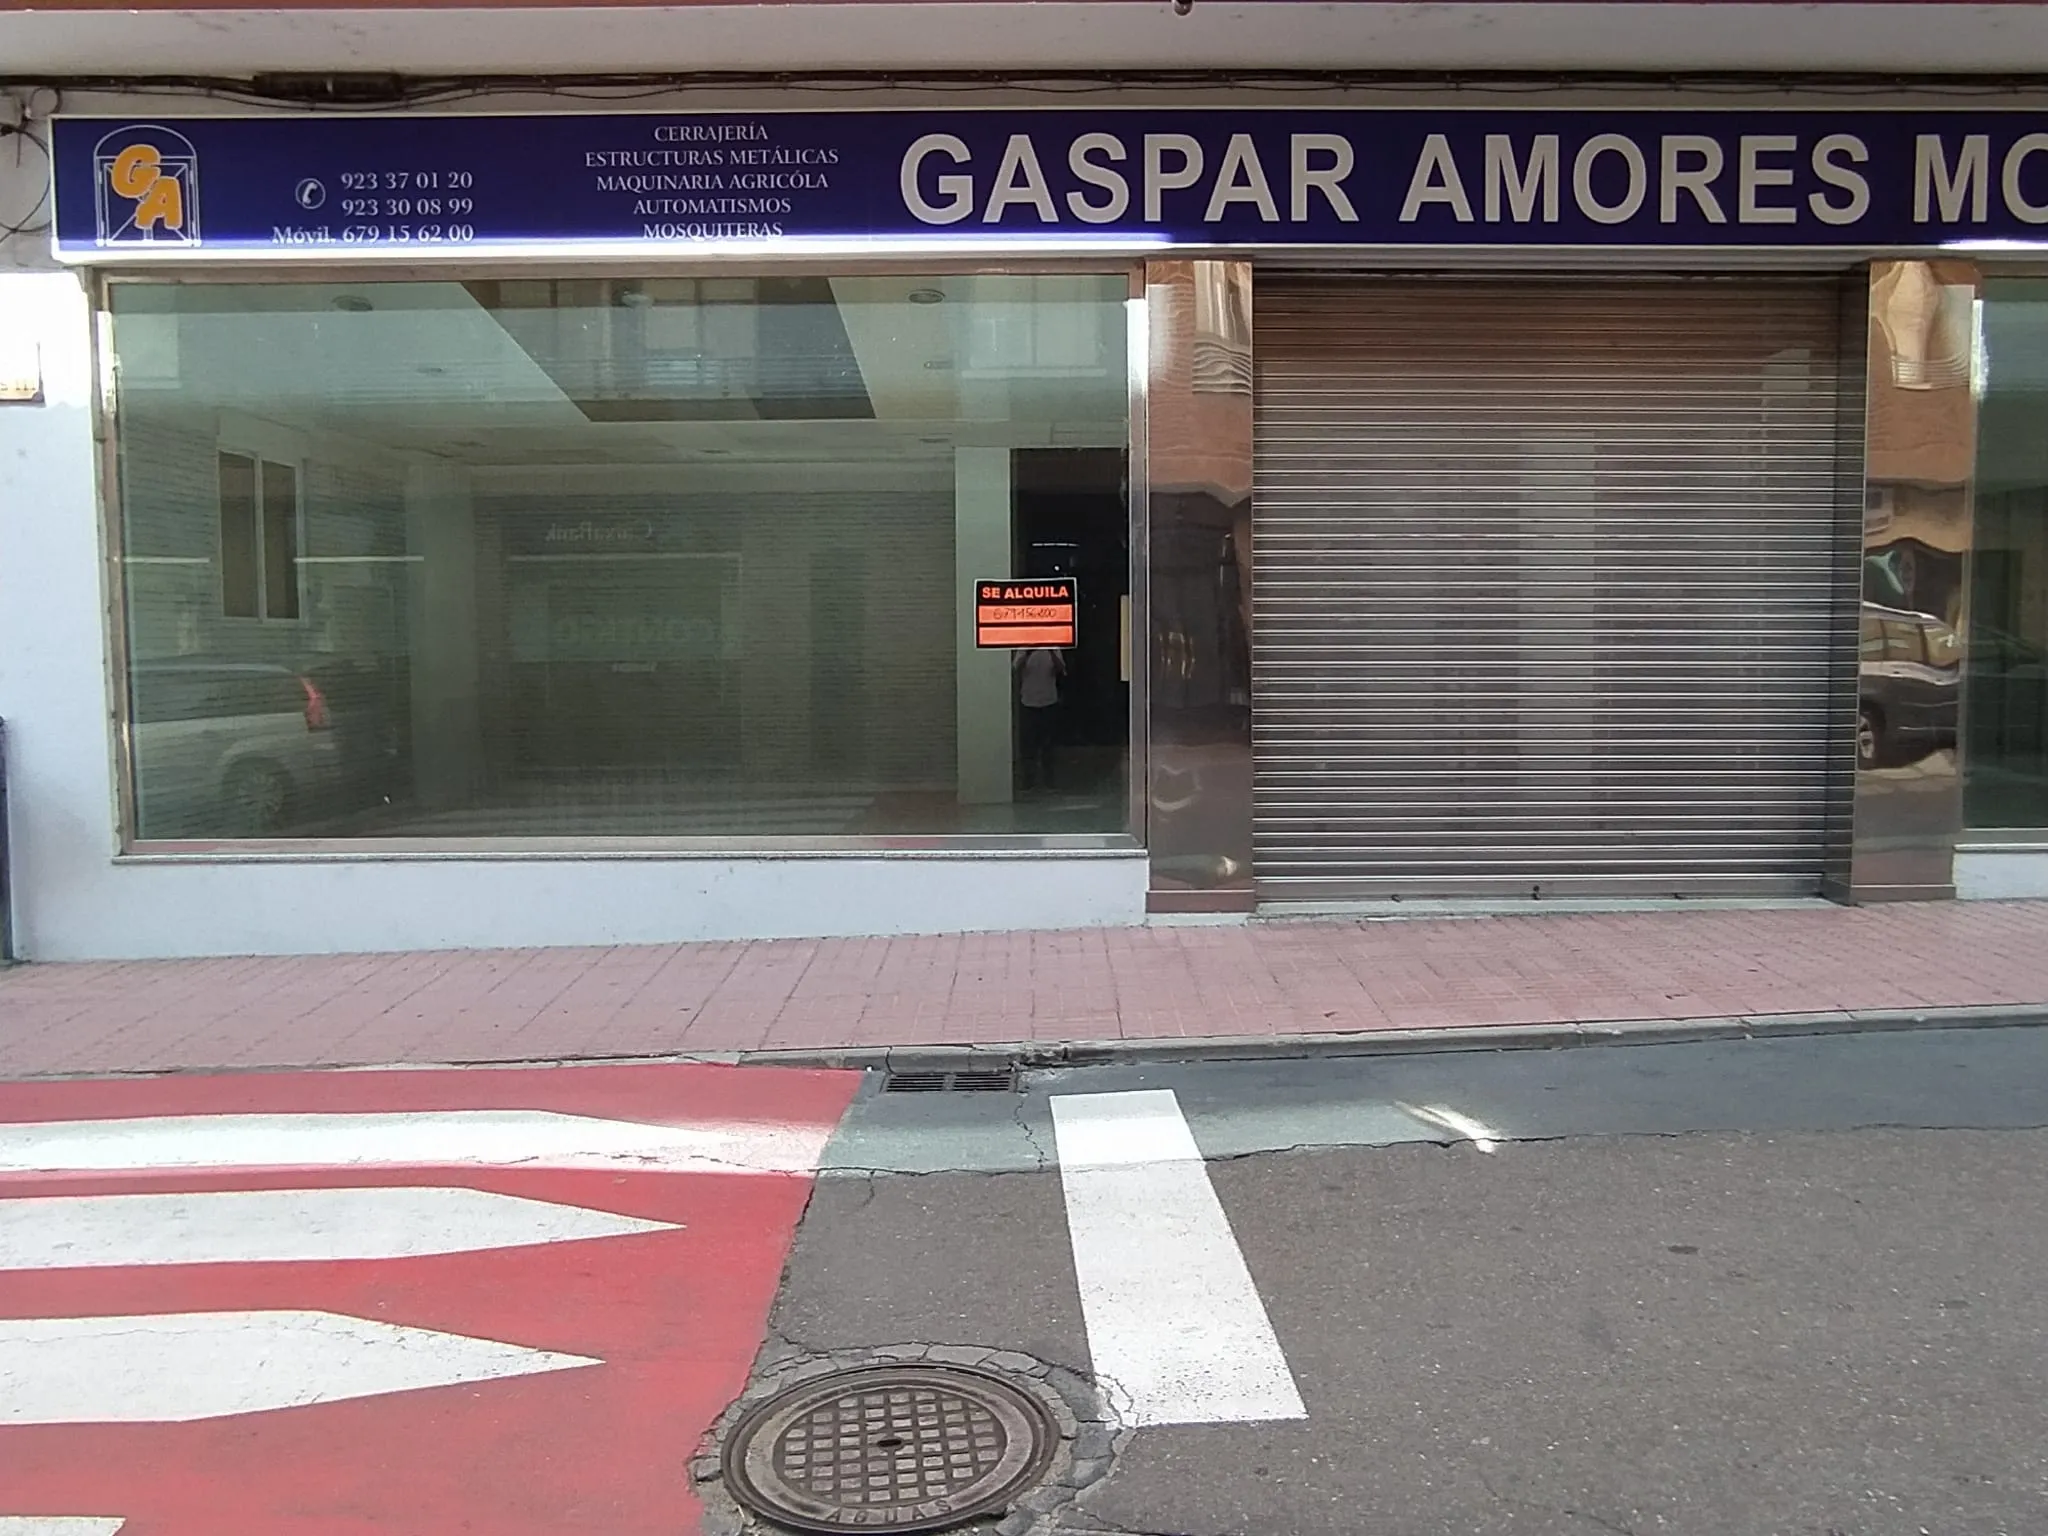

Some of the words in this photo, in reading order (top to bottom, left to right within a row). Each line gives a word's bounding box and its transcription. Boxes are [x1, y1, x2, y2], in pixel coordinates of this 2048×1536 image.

[653, 122, 768, 143] CERRAJERÍA
[584, 150, 723, 167] ESTRUCTURAS
[729, 145, 839, 165] METÁLICAS
[341, 172, 379, 191] 923
[385, 172, 410, 191] 37
[416, 172, 440, 190] 01
[447, 172, 473, 190] 20
[596, 174, 723, 193] MAQUINARIA
[728, 170, 828, 189] AGRICÓLA
[900, 133, 1359, 225] GASPAR
[1398, 133, 1870, 225] AMORES
[341, 198, 379, 217] 923
[384, 198, 410, 217] 30
[416, 198, 441, 216] 08
[447, 198, 473, 216] 99
[633, 198, 791, 214] AUTOMATISMOS
[271, 224, 337, 245] Móvil.
[342, 224, 380, 244] 679
[387, 225, 411, 244] 15
[417, 224, 441, 243] 62
[447, 224, 474, 243] 00
[643, 222, 783, 241] MOSQUITERAS
[982, 587, 1001, 599] SE
[1004, 586, 1069, 599] ALQUILA
